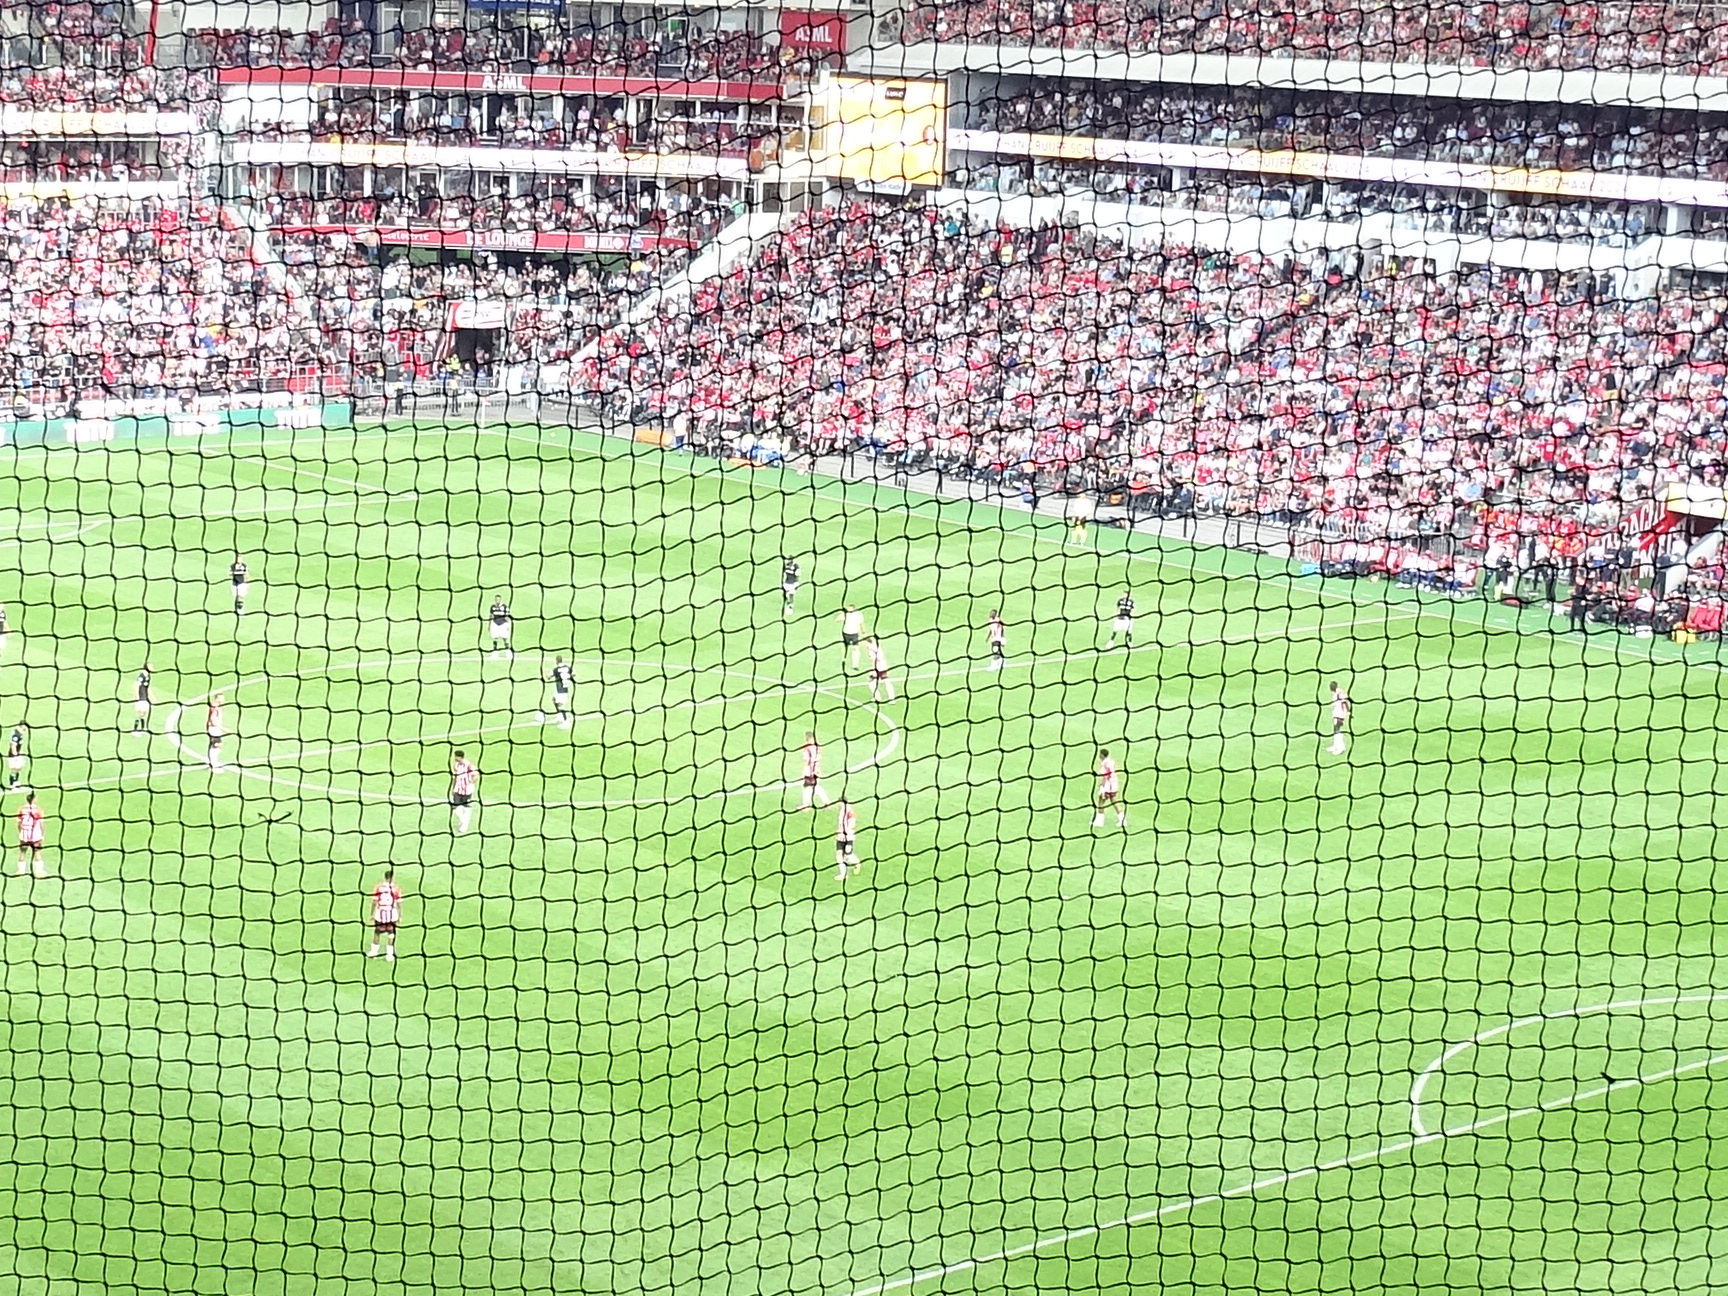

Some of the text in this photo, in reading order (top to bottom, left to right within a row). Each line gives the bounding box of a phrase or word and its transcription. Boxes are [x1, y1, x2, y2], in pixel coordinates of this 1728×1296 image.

[795, 25, 832, 43] ASML
[482, 75, 525, 90] ASML
[485, 230, 534, 247] LOUNGE
